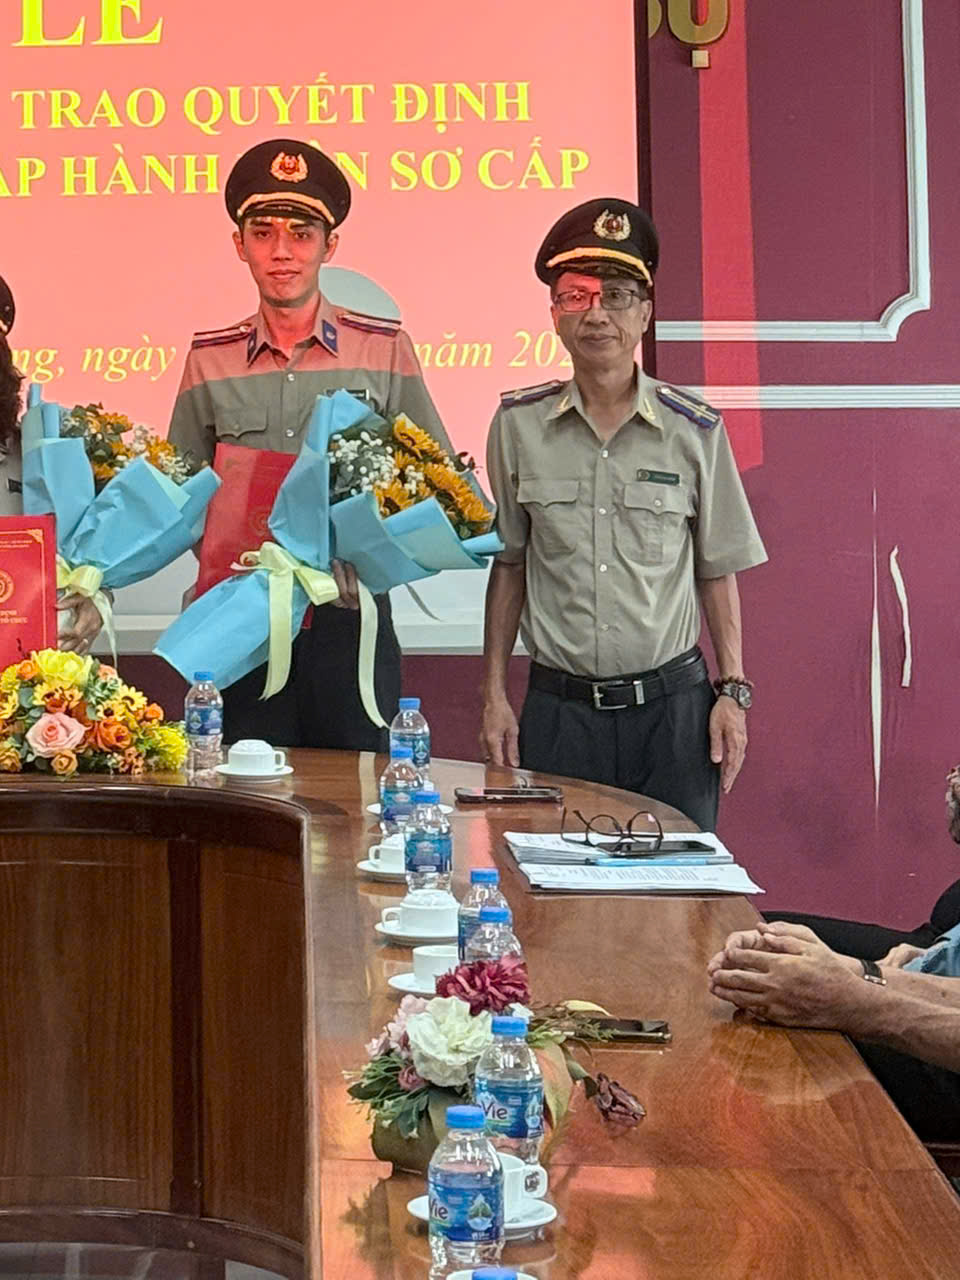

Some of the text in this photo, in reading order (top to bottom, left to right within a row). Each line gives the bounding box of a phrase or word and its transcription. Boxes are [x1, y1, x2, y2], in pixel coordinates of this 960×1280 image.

[10, 86, 167, 131] TRAO
[183, 71, 376, 136] QUYẾT
[391, 80, 532, 135] ĐỊNH
[59, 143, 220, 197] HÀNH
[389, 146, 464, 193] SƠ
[477, 136, 590, 192] CẤP
[81, 334, 177, 384] ngày
[414, 332, 493, 368] năm
